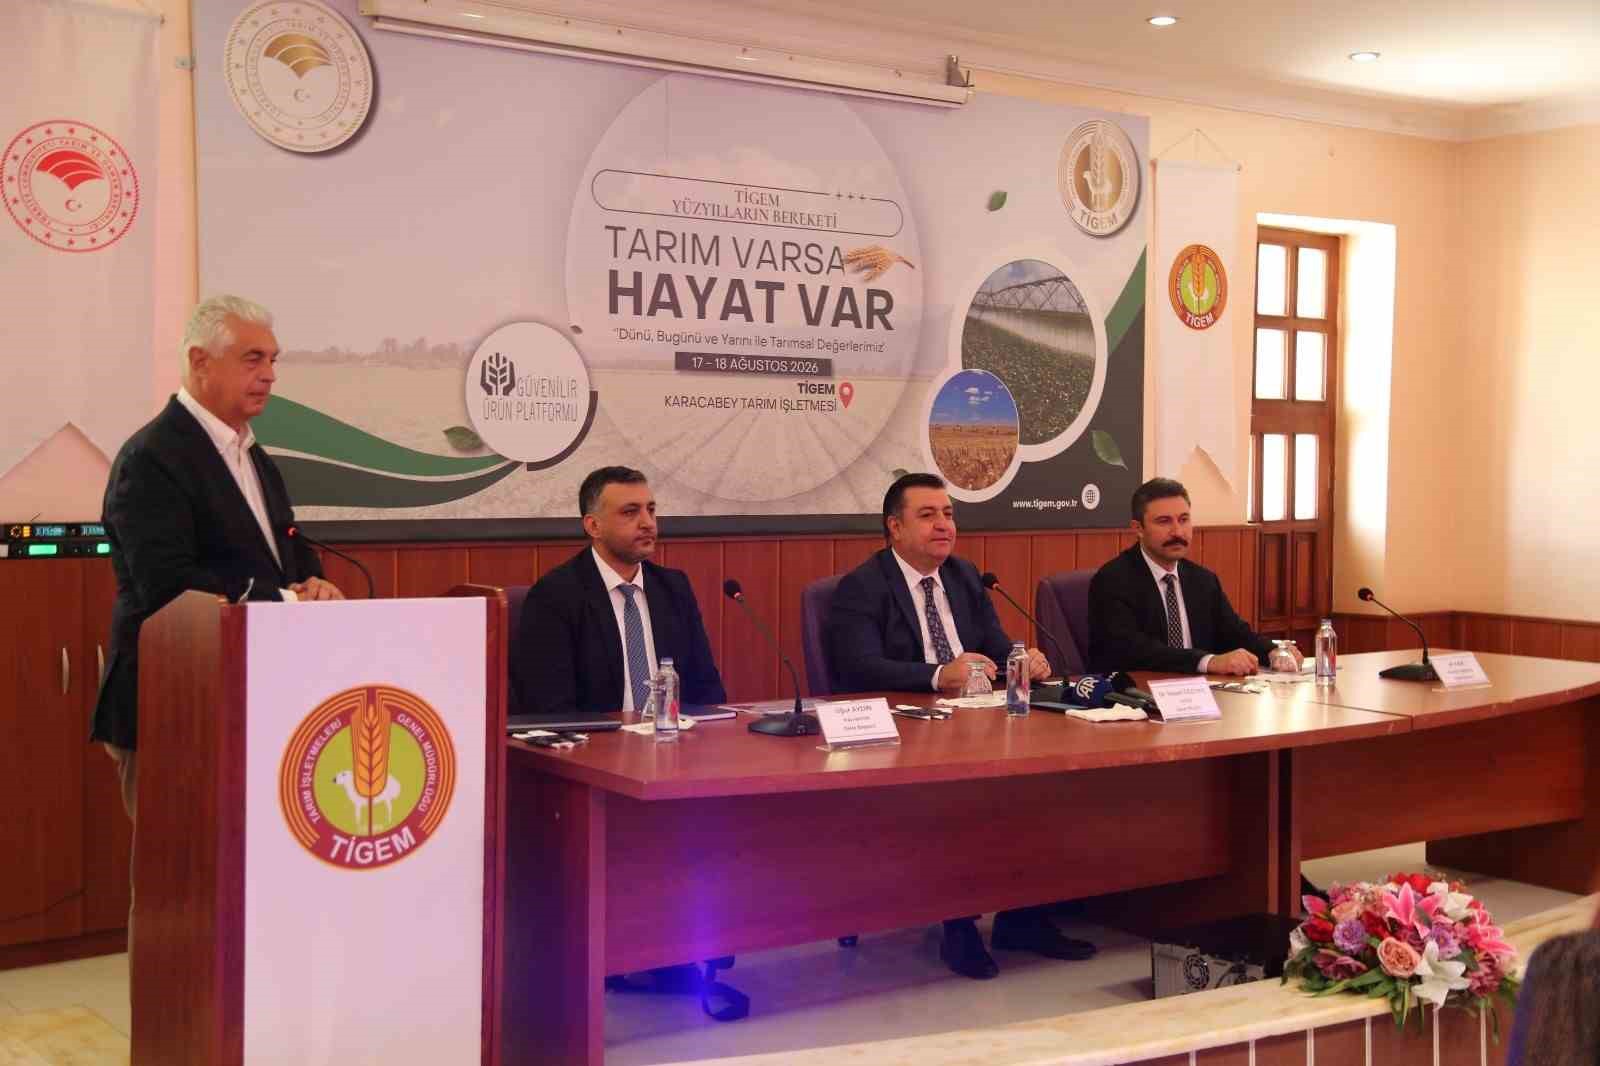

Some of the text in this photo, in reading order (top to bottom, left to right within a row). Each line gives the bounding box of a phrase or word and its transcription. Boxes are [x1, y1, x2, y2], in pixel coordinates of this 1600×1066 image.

[734, 187, 780, 208] TİGEM
[672, 198, 838, 229] YÜZYILLARIN BEREKETİ
[604, 225, 847, 275] TARIM VARSA
[608, 269, 895, 331] HAYAT VAR
[656, 330, 701, 346] Bugünü
[705, 335, 719, 345] ve
[721, 334, 752, 346] Yarını
[769, 336, 815, 350] Tarımsal
[692, 356, 704, 369] 17
[715, 357, 728, 370] 18
[730, 356, 789, 372] AĞUSTOS
[790, 360, 819, 373] 2026
[797, 380, 835, 395] TİGEM
[483, 398, 578, 422] ÜRÜN PLATFORMU
[664, 395, 837, 414] KARACABEY TARIM İŞLETMESİ
[1012, 498, 1078, 510] www.tigem.gov.tr
[397, 713, 425, 742] GENEL
[303, 790, 321, 824] TARIM
[329, 825, 417, 864] TİGEM
